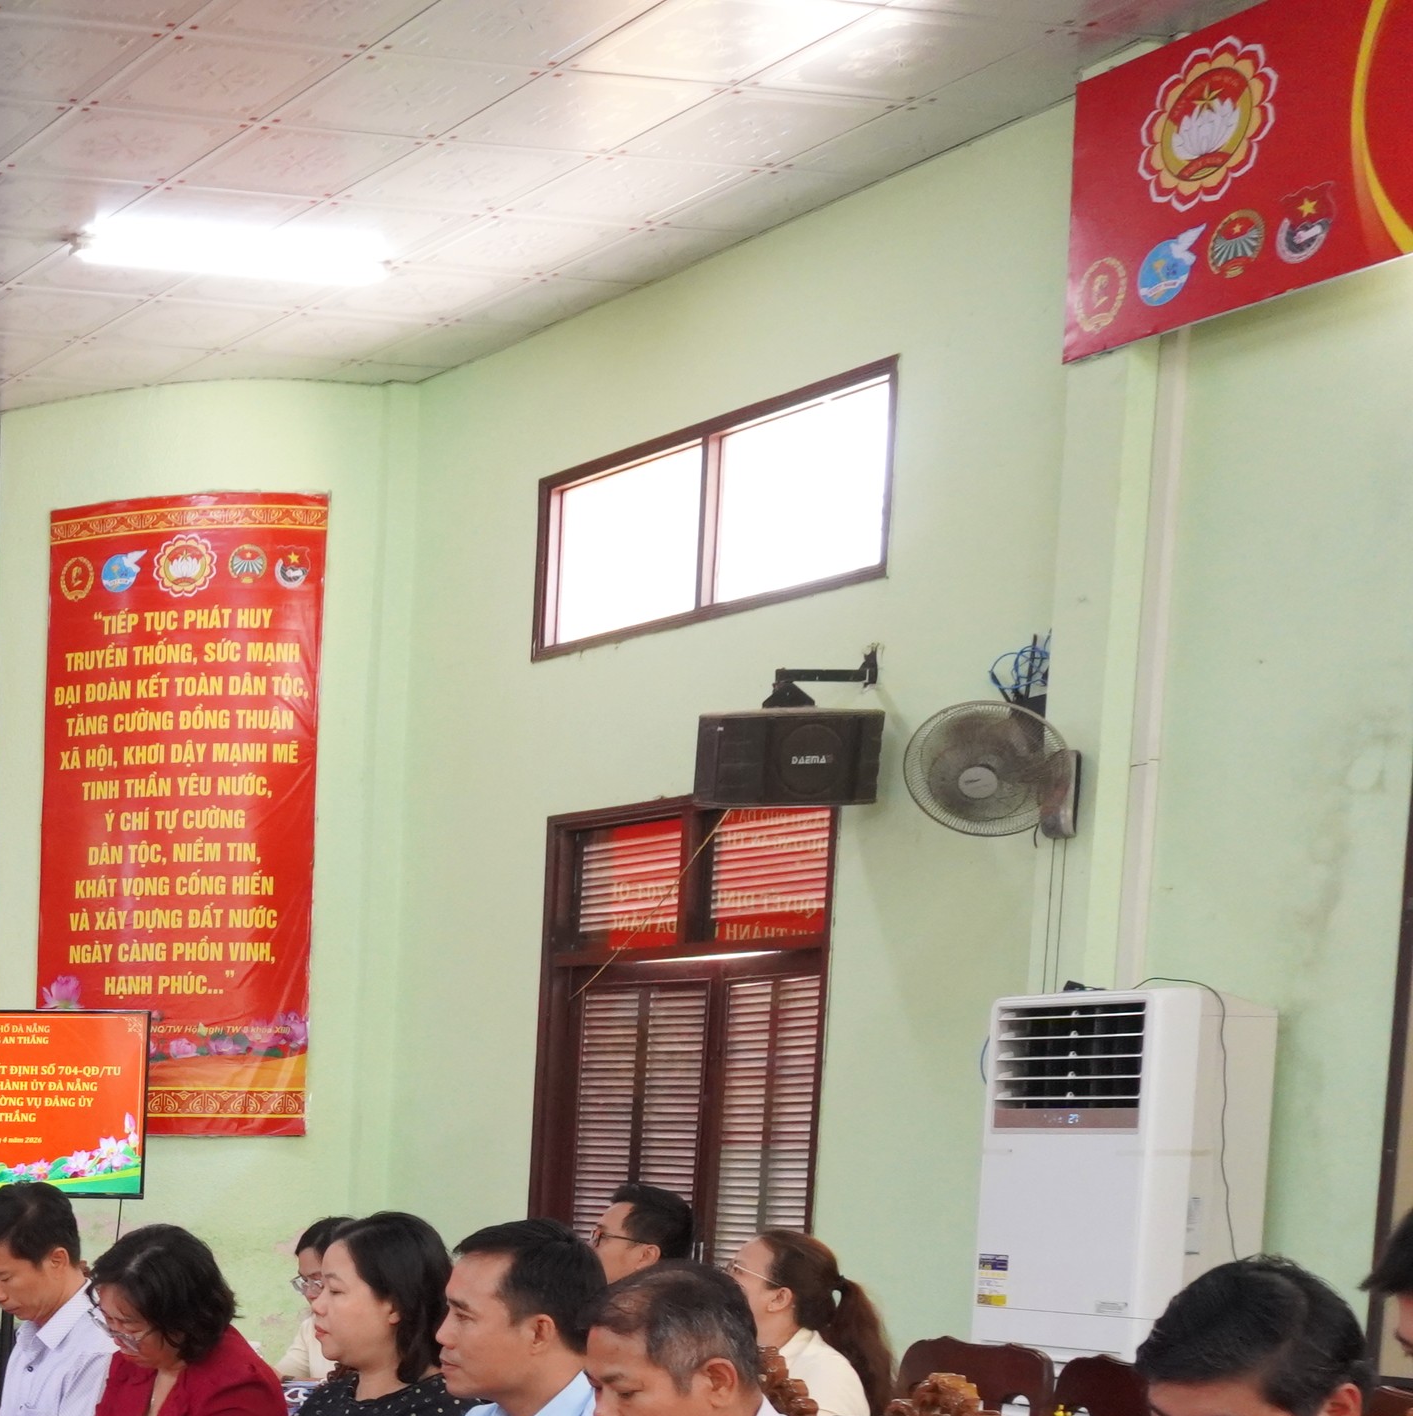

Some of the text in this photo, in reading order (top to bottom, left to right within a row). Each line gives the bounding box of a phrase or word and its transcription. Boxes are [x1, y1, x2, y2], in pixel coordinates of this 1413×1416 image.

[144, 610, 179, 635] TỤC
[183, 604, 232, 630] PHÁT
[237, 608, 273, 628] HUY
[65, 638, 300, 672] TRUYỀN THỐNG, SỨC MẠNH
[54, 672, 308, 708] ĐẠI ĐOÀN KẾT TOÀN DÂN TỘC,
[26, 1097, 42, 1109] VỤ
[44, 1095, 76, 1107] ĐẢNG
[78, 1095, 94, 1107] ỦY
